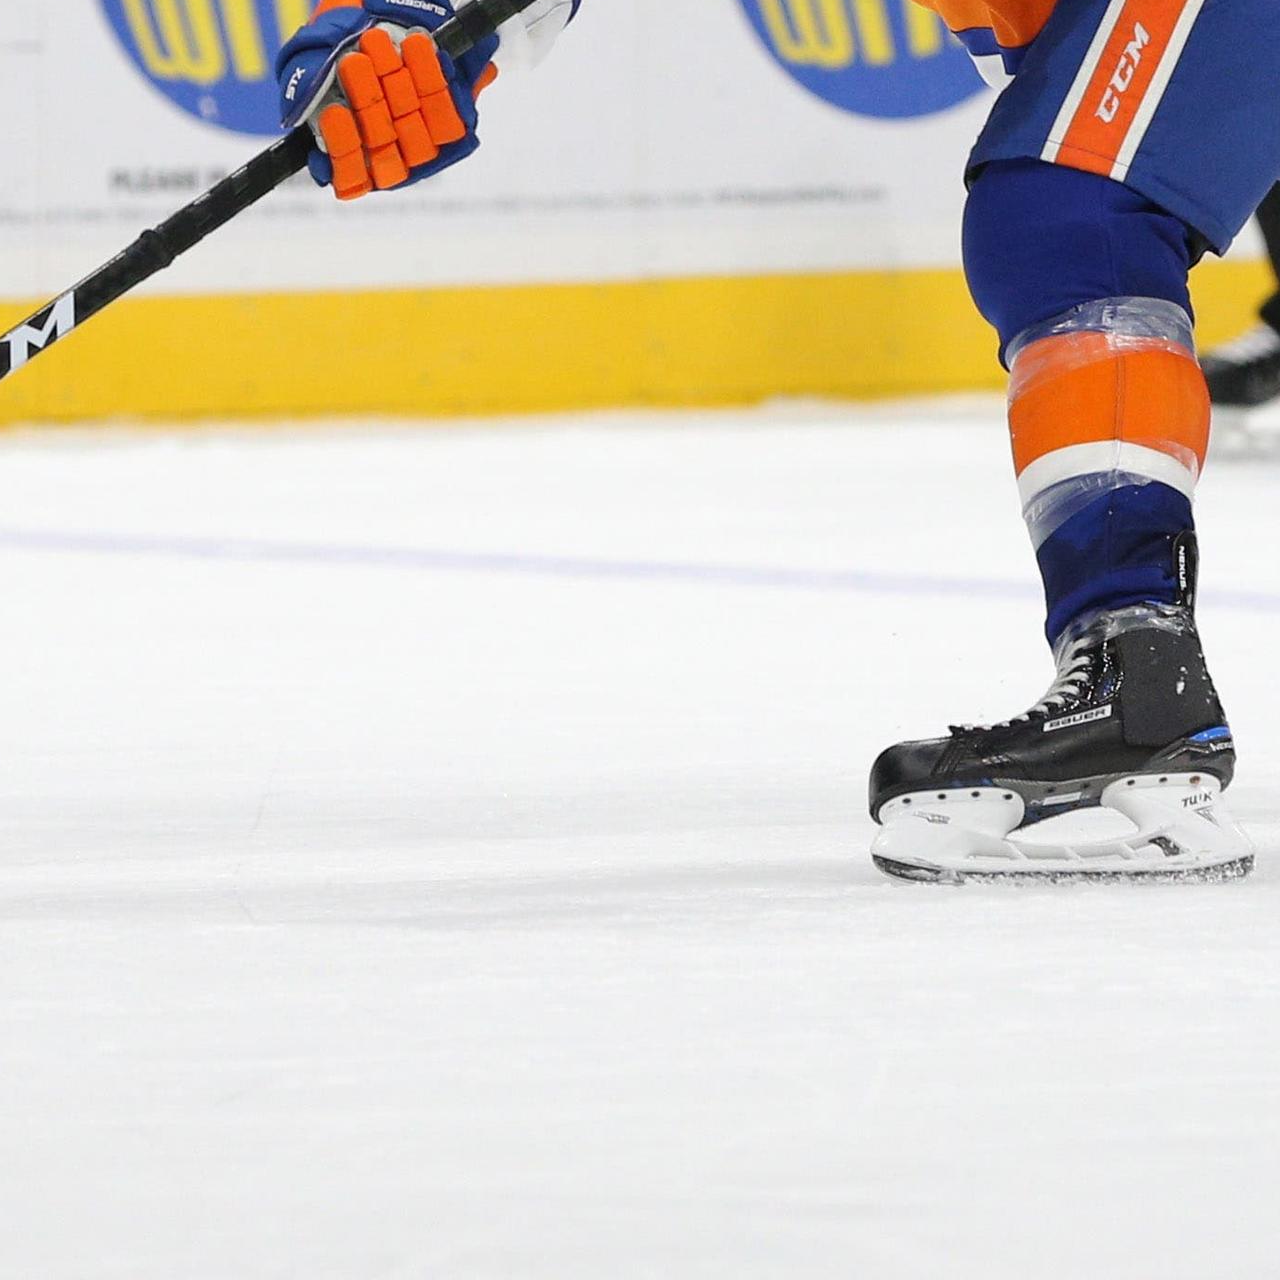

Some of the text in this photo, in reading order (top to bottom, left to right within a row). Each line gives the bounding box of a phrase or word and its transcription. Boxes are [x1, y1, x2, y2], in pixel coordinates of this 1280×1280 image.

[285, 66, 306, 101] STX
[1094, 21, 1150, 124] CCM
[1048, 707, 1109, 730] BAUER
